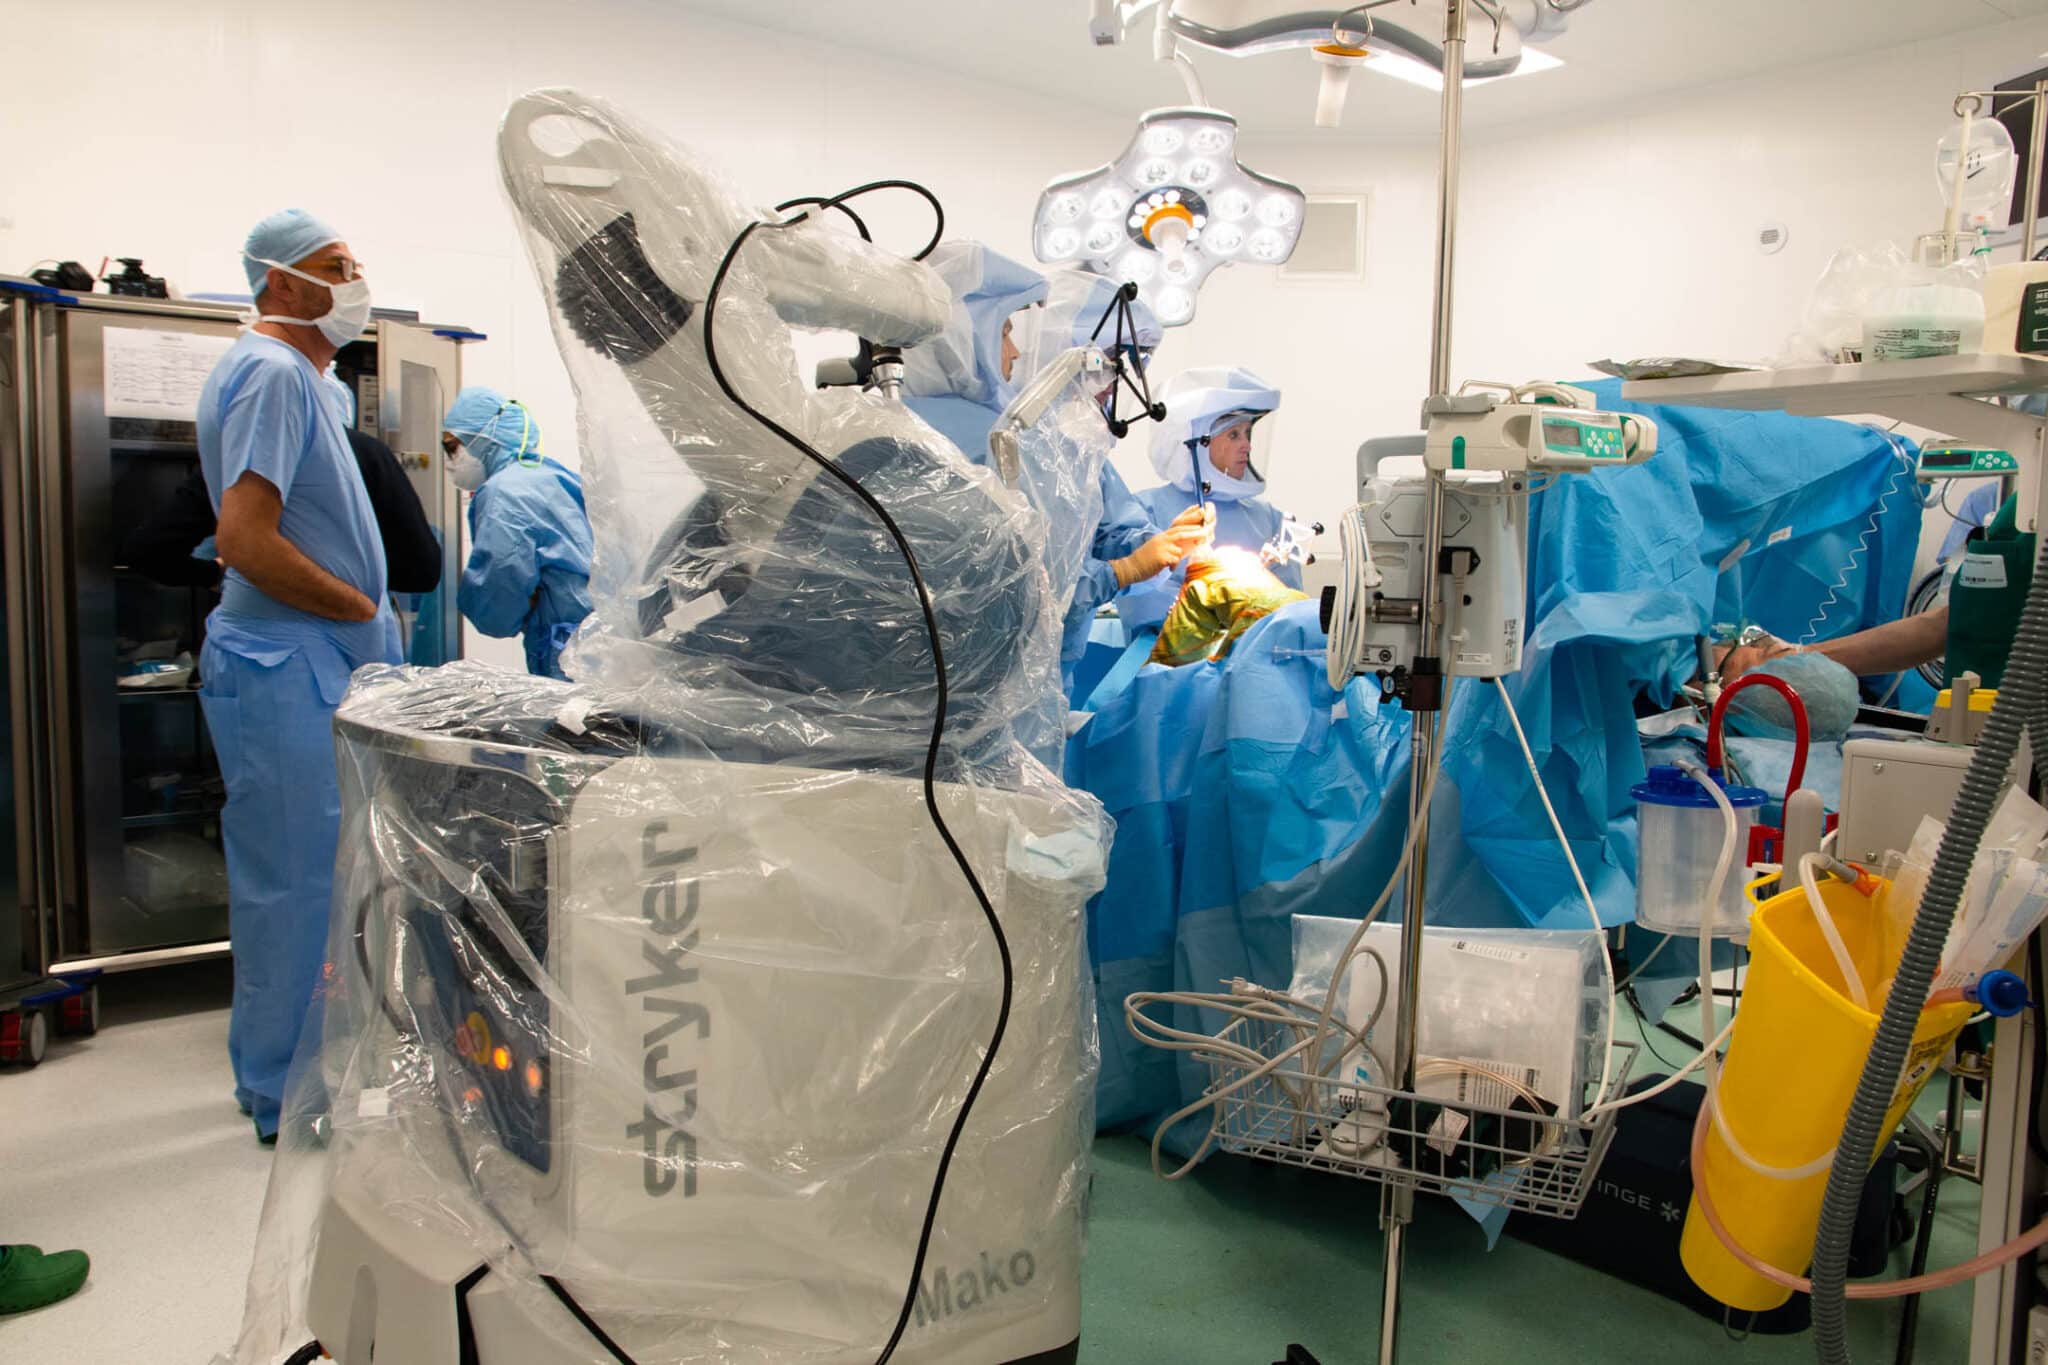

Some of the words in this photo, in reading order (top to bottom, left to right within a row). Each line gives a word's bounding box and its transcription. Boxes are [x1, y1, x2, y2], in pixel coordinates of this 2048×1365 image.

[625, 820, 710, 1197] stryker
[1595, 1179, 1653, 1212] INGE
[911, 1249, 1036, 1328] Mako
